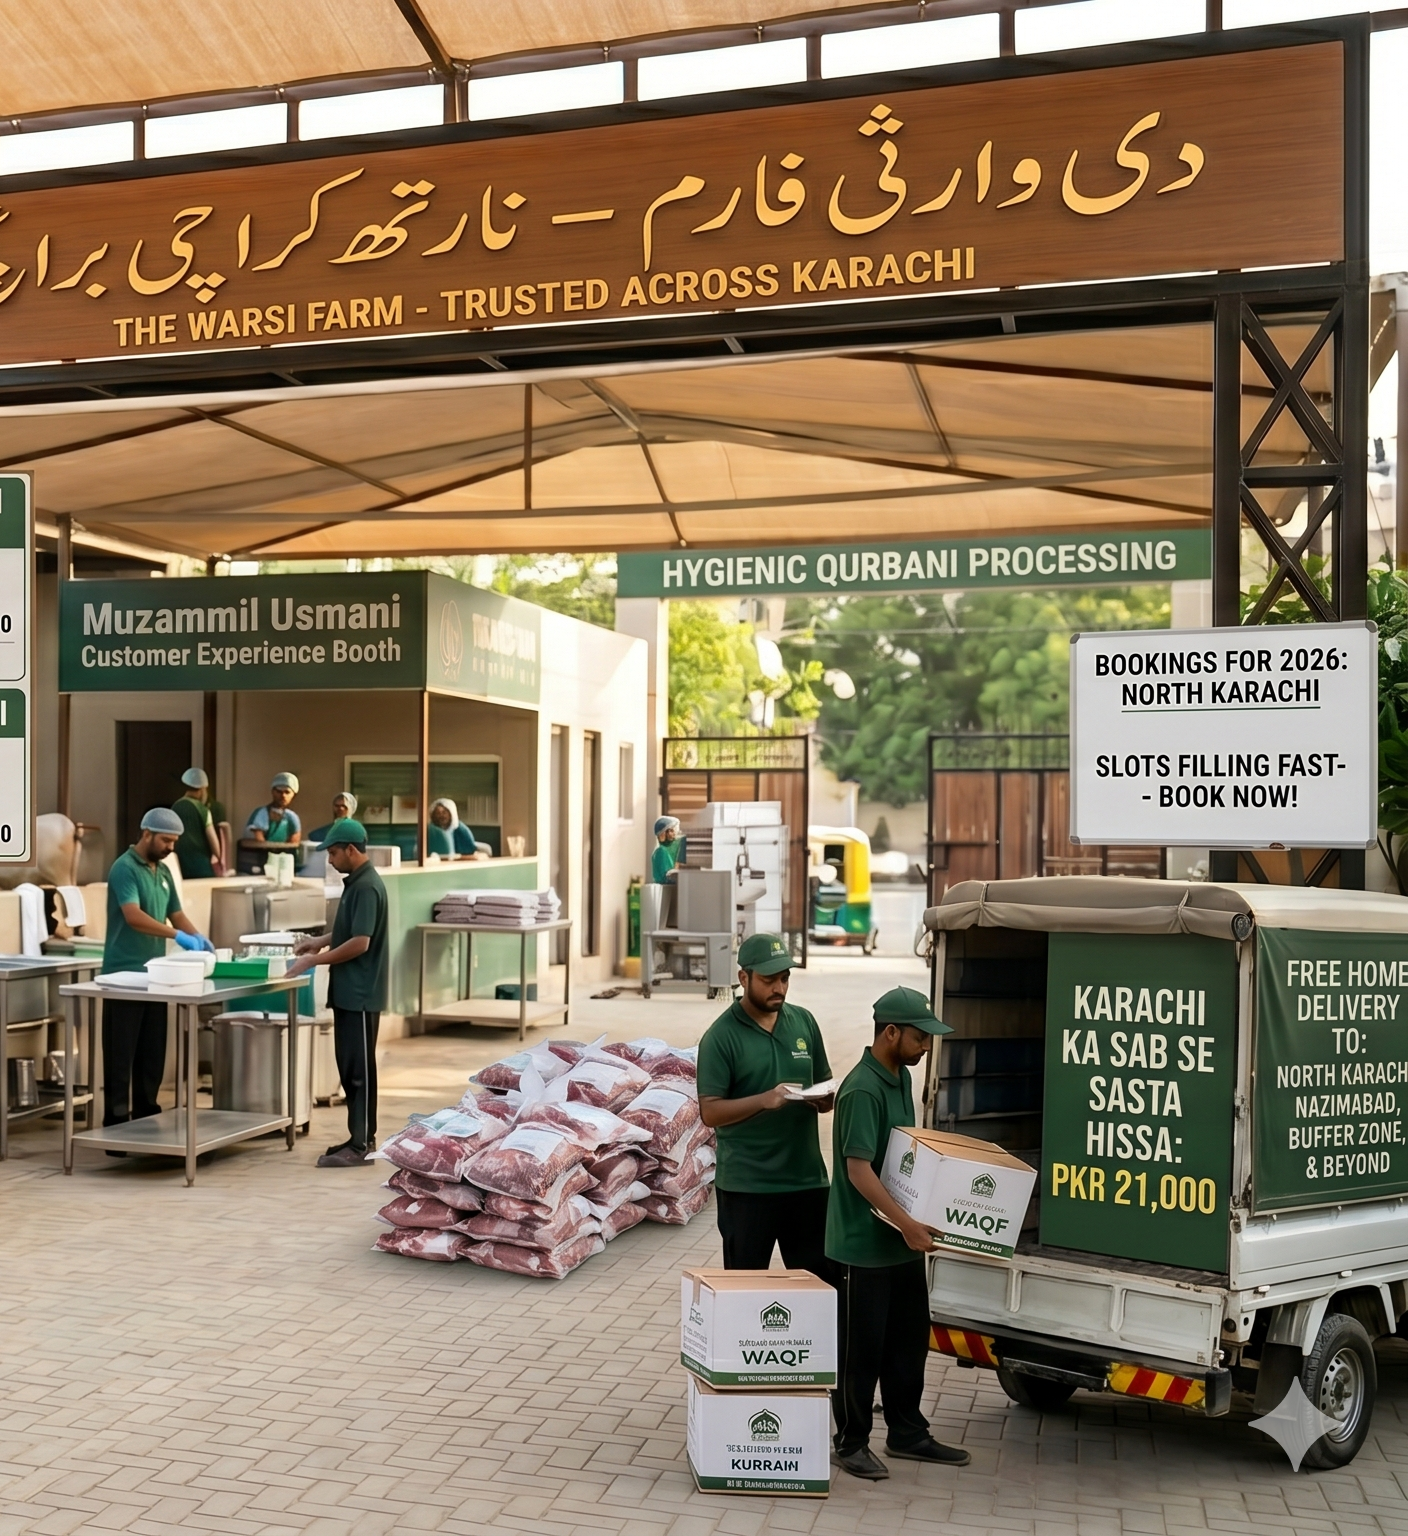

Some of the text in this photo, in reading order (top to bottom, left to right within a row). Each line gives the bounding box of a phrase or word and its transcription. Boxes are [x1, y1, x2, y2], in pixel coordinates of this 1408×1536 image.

[828, 104, 1042, 235] وارثی
[1062, 111, 1206, 215] دی
[328, 180, 527, 264] نارتھ
[642, 152, 807, 271] فارم
[126, 167, 365, 303] کراچی
[113, 314, 177, 347] THE
[188, 304, 295, 340] WARSI
[308, 295, 403, 331] FARM
[440, 279, 609, 321] TRUSTED
[621, 264, 779, 307] ACROSS
[793, 246, 974, 293] KARACHI
[663, 540, 1177, 588] HYGIENIC QURBANI PROCESSING
[83, 593, 400, 635] Muzammil Usmani
[81, 637, 401, 671] Customer Experience Booth
[1095, 647, 1348, 676] BOOKINGS FOR 2026:
[1122, 678, 1320, 705] NORTH KARACHI
[1096, 753, 1346, 778] SLOTS FILLING FAST-
[1159, 785, 1226, 808] BOOK
[1233, 785, 1298, 808] NOW!
[1287, 960, 1408, 987] FREE HOME
[1073, 985, 1206, 1026] KARACHI
[1297, 994, 1400, 1021] DELIVERY
[1062, 1029, 1215, 1073] KA SAB SE
[1332, 1027, 1366, 1055] TO:
[1277, 1063, 1336, 1089] NORTH
[1089, 1076, 1182, 1117] SASTA
[1295, 1092, 1401, 1119] NAZIMABAD,
[1086, 1121, 1182, 1164] HISSA:
[1289, 1121, 1406, 1150] BUFFER ZONE,
[1306, 1151, 1390, 1179] & BEYOND
[1051, 1163, 1216, 1215] PKR 21,000
[945, 1207, 1009, 1236] WAQF
[742, 1349, 810, 1367] WAQF
